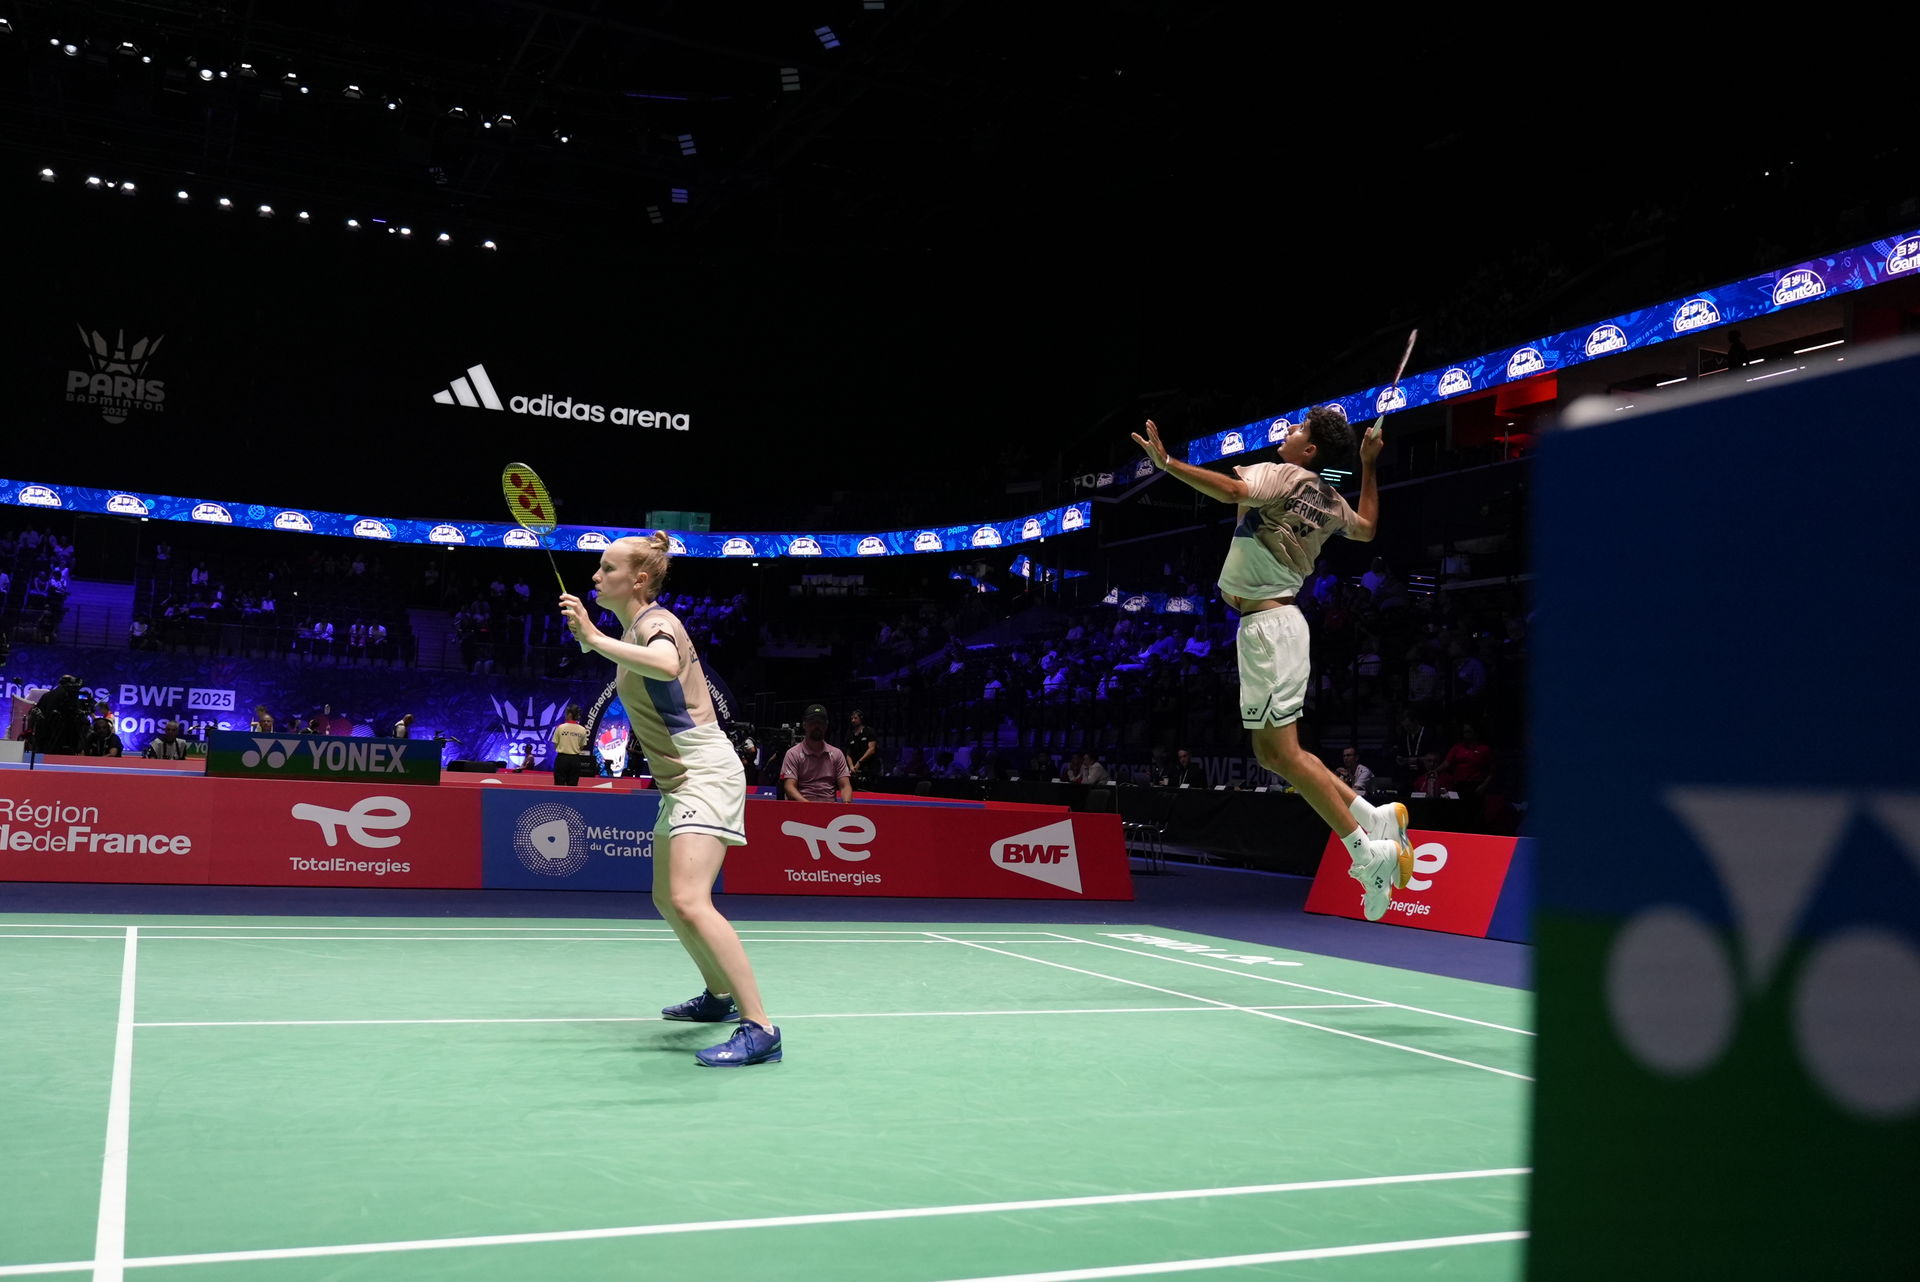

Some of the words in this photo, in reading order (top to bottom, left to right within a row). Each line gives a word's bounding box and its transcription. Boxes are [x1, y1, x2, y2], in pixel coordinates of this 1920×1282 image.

[1776, 281, 1821, 302] Ganten
[66, 370, 166, 402] PARIS
[102, 407, 128, 416] 2025
[509, 394, 605, 423] adidas
[610, 407, 690, 431] arena
[119, 684, 185, 707] BWF
[190, 691, 232, 707] 2025
[307, 740, 407, 773] YONEX
[0, 798, 99, 828] Région
[0, 824, 192, 855] ledeFrance
[590, 843, 601, 851] du
[604, 843, 652, 857] Grand
[1002, 844, 1070, 864] BWF
[289, 857, 411, 875] TotalEnergies
[784, 869, 882, 886] TotalEnergies
